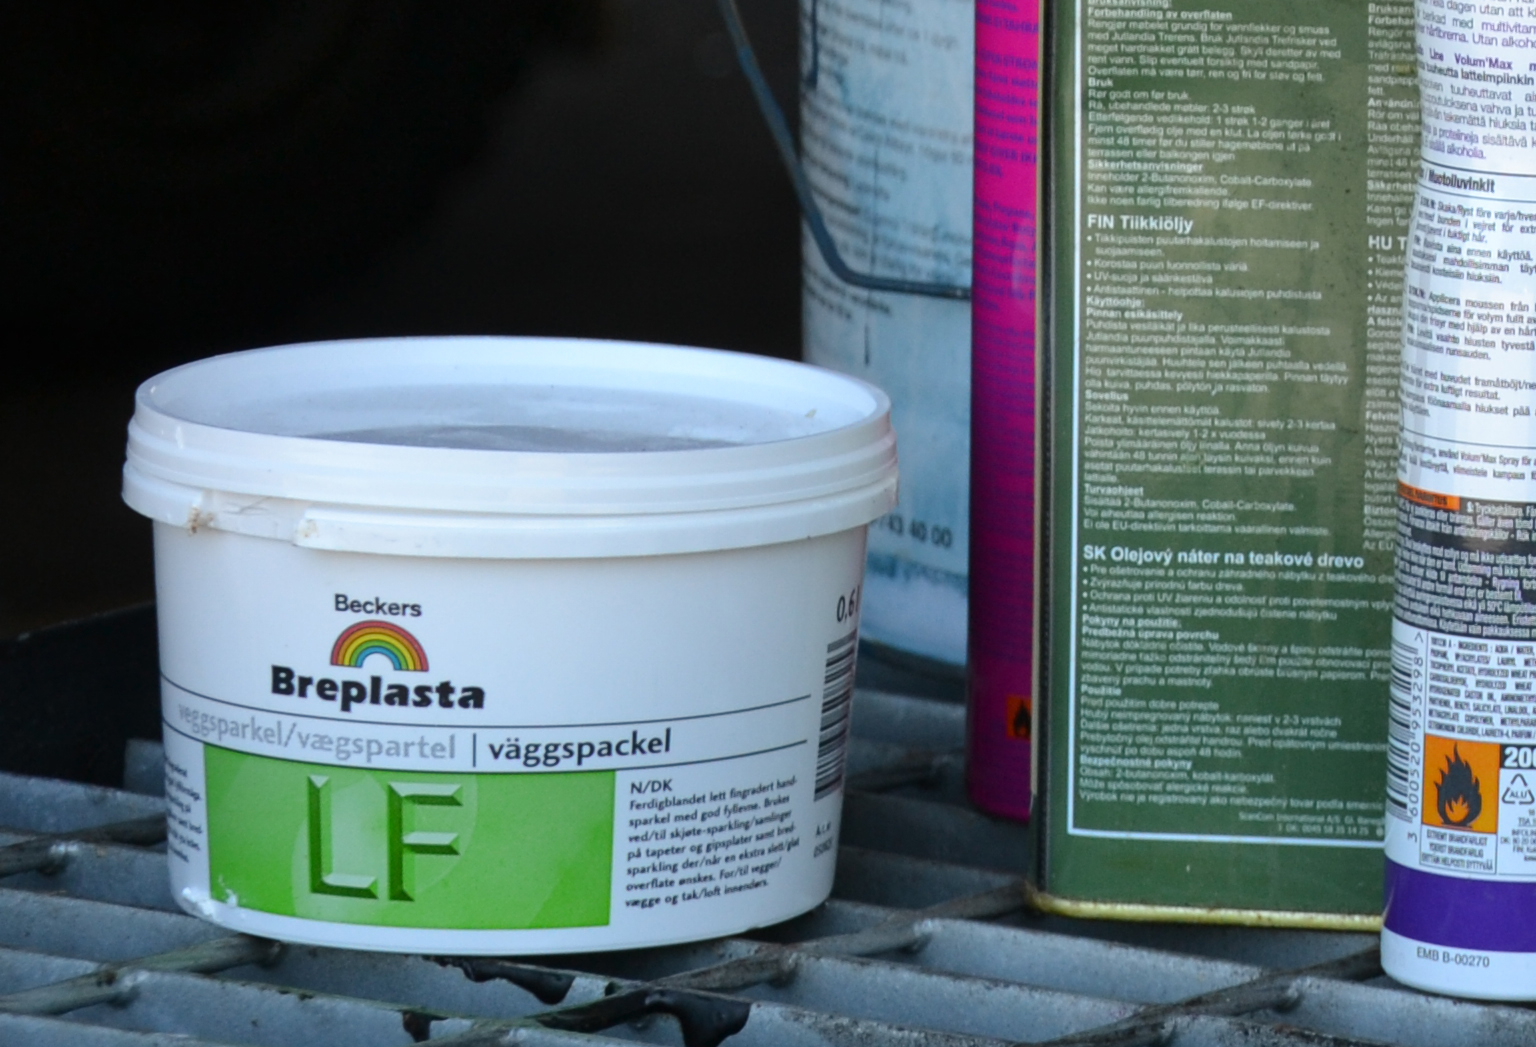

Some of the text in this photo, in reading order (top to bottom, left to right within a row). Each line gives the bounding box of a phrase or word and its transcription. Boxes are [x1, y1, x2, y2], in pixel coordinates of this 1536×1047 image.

[1087, 215, 1193, 234] FIN Tiikkiöljy
[1083, 545, 1364, 568] SK Olejový náter na teakové drevo
[335, 593, 422, 618] Beckers
[271, 665, 485, 712] Breplasta
[489, 727, 671, 767] väggspackel
[630, 779, 672, 794] N/DK
[629, 813, 670, 829] sparkel
[308, 775, 464, 903] LF
[626, 878, 675, 892] overflate
[1416, 946, 1490, 968] EMB B-00270
